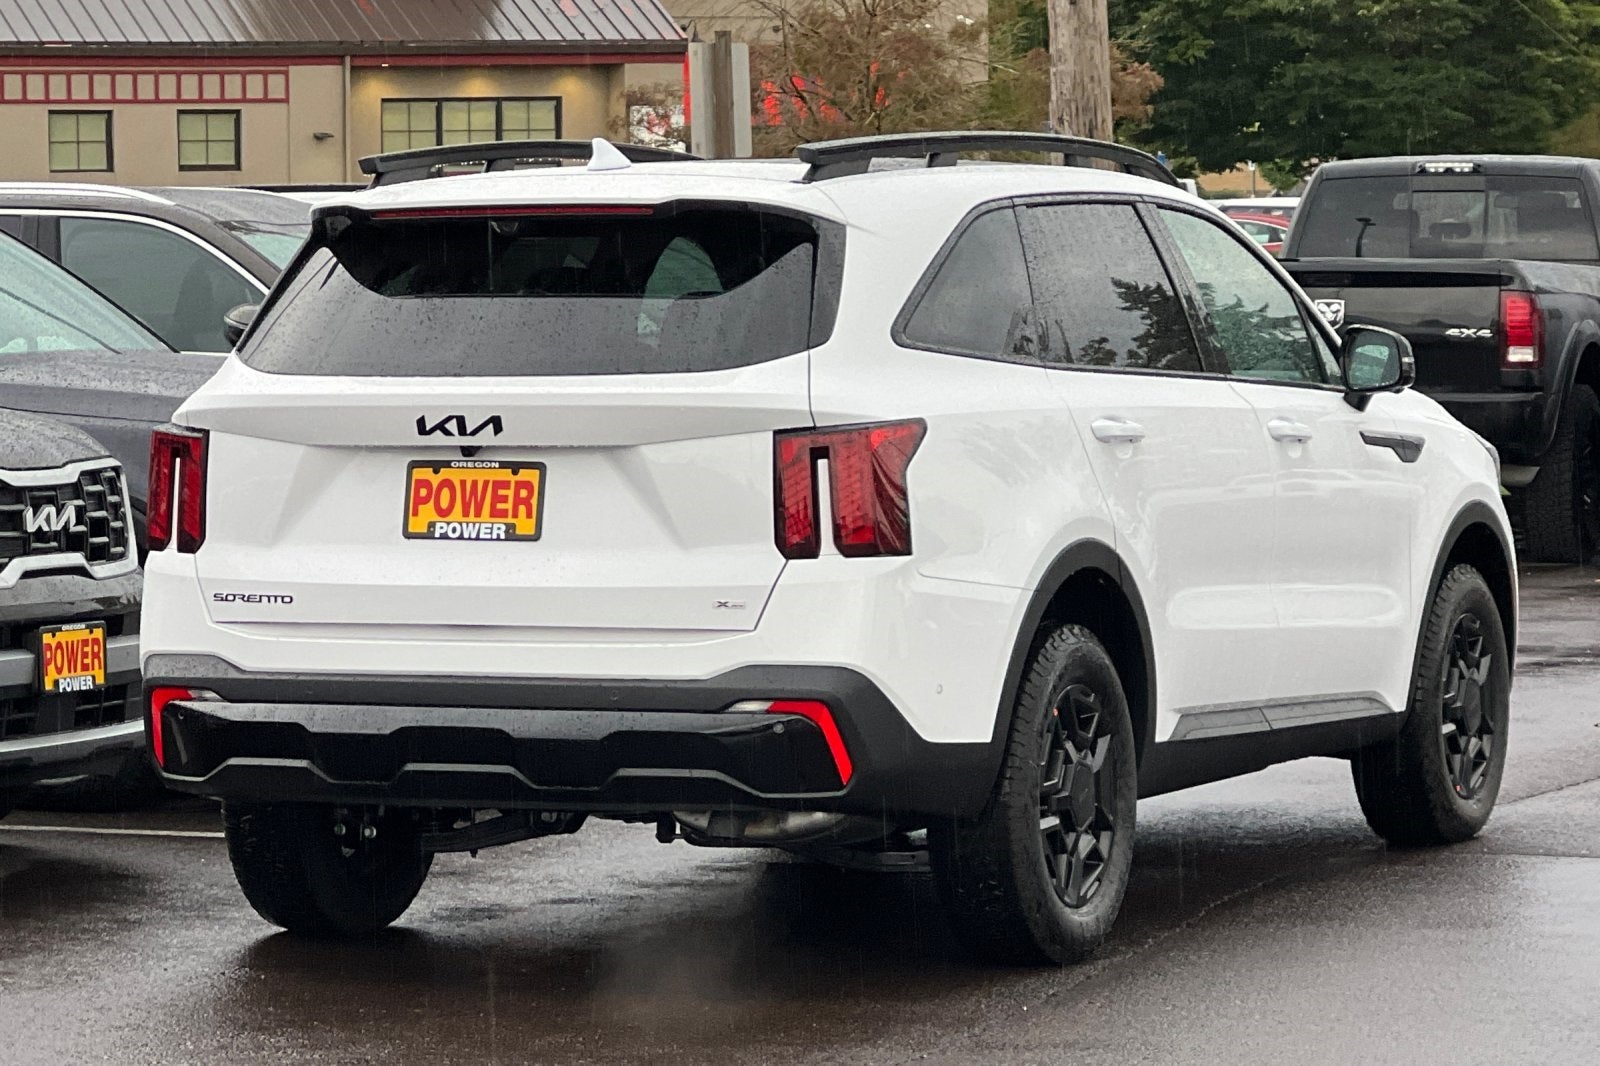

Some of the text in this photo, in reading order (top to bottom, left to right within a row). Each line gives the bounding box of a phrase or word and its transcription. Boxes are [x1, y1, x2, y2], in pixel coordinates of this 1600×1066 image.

[416, 415, 503, 436] KIA
[411, 478, 535, 519] POWER
[25, 504, 76, 532] KIA
[434, 522, 506, 539] POWER
[213, 592, 293, 604] SORENTO
[43, 637, 102, 676] POWER
[59, 676, 93, 692] POWER
